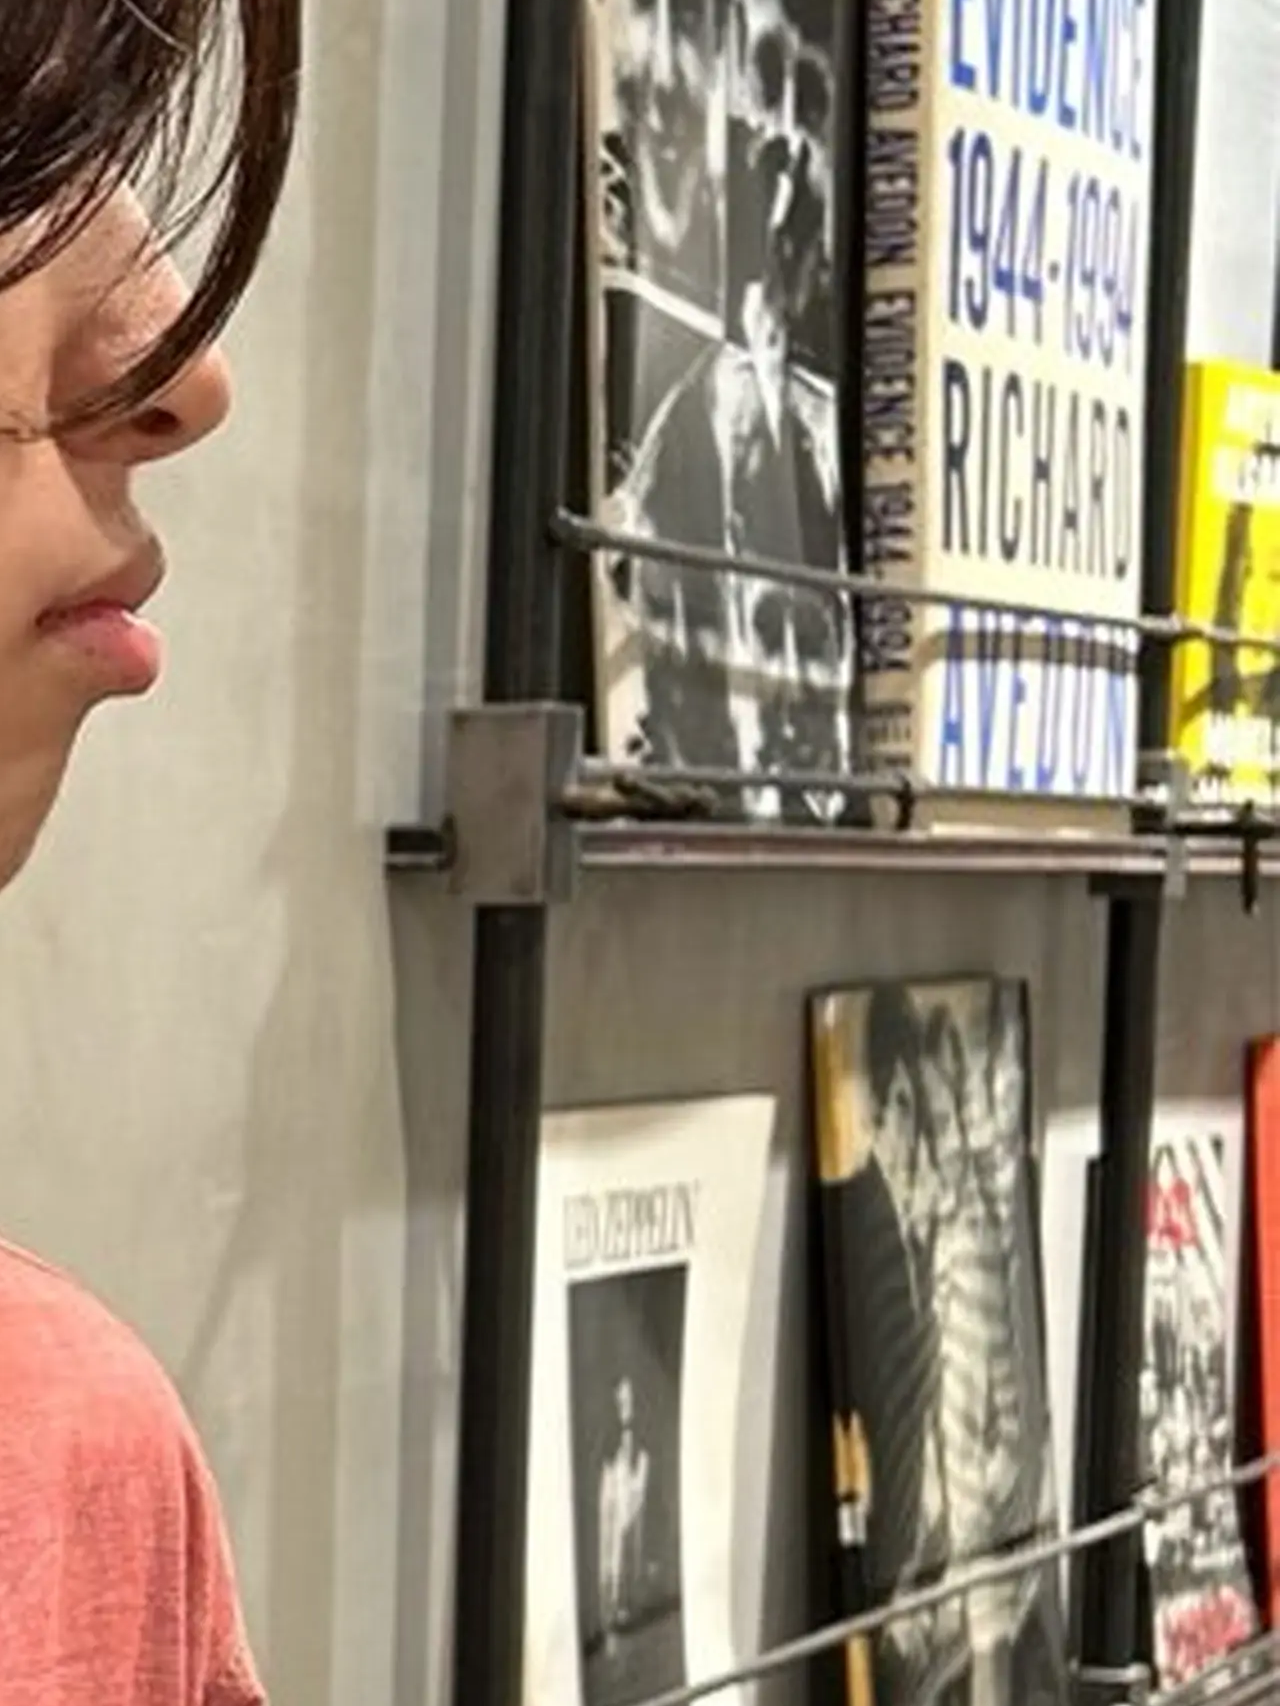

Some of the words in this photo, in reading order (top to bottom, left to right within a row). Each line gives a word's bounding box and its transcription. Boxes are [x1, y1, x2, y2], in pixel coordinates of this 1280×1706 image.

[865, 130, 919, 268] AVEDON
[947, 125, 1140, 373] 1944-1994
[863, 288, 917, 463] EVIDENCE
[941, 357, 1133, 581] RICHARD
[863, 480, 916, 672] 1944-994
[939, 603, 1130, 794] AVEDON
